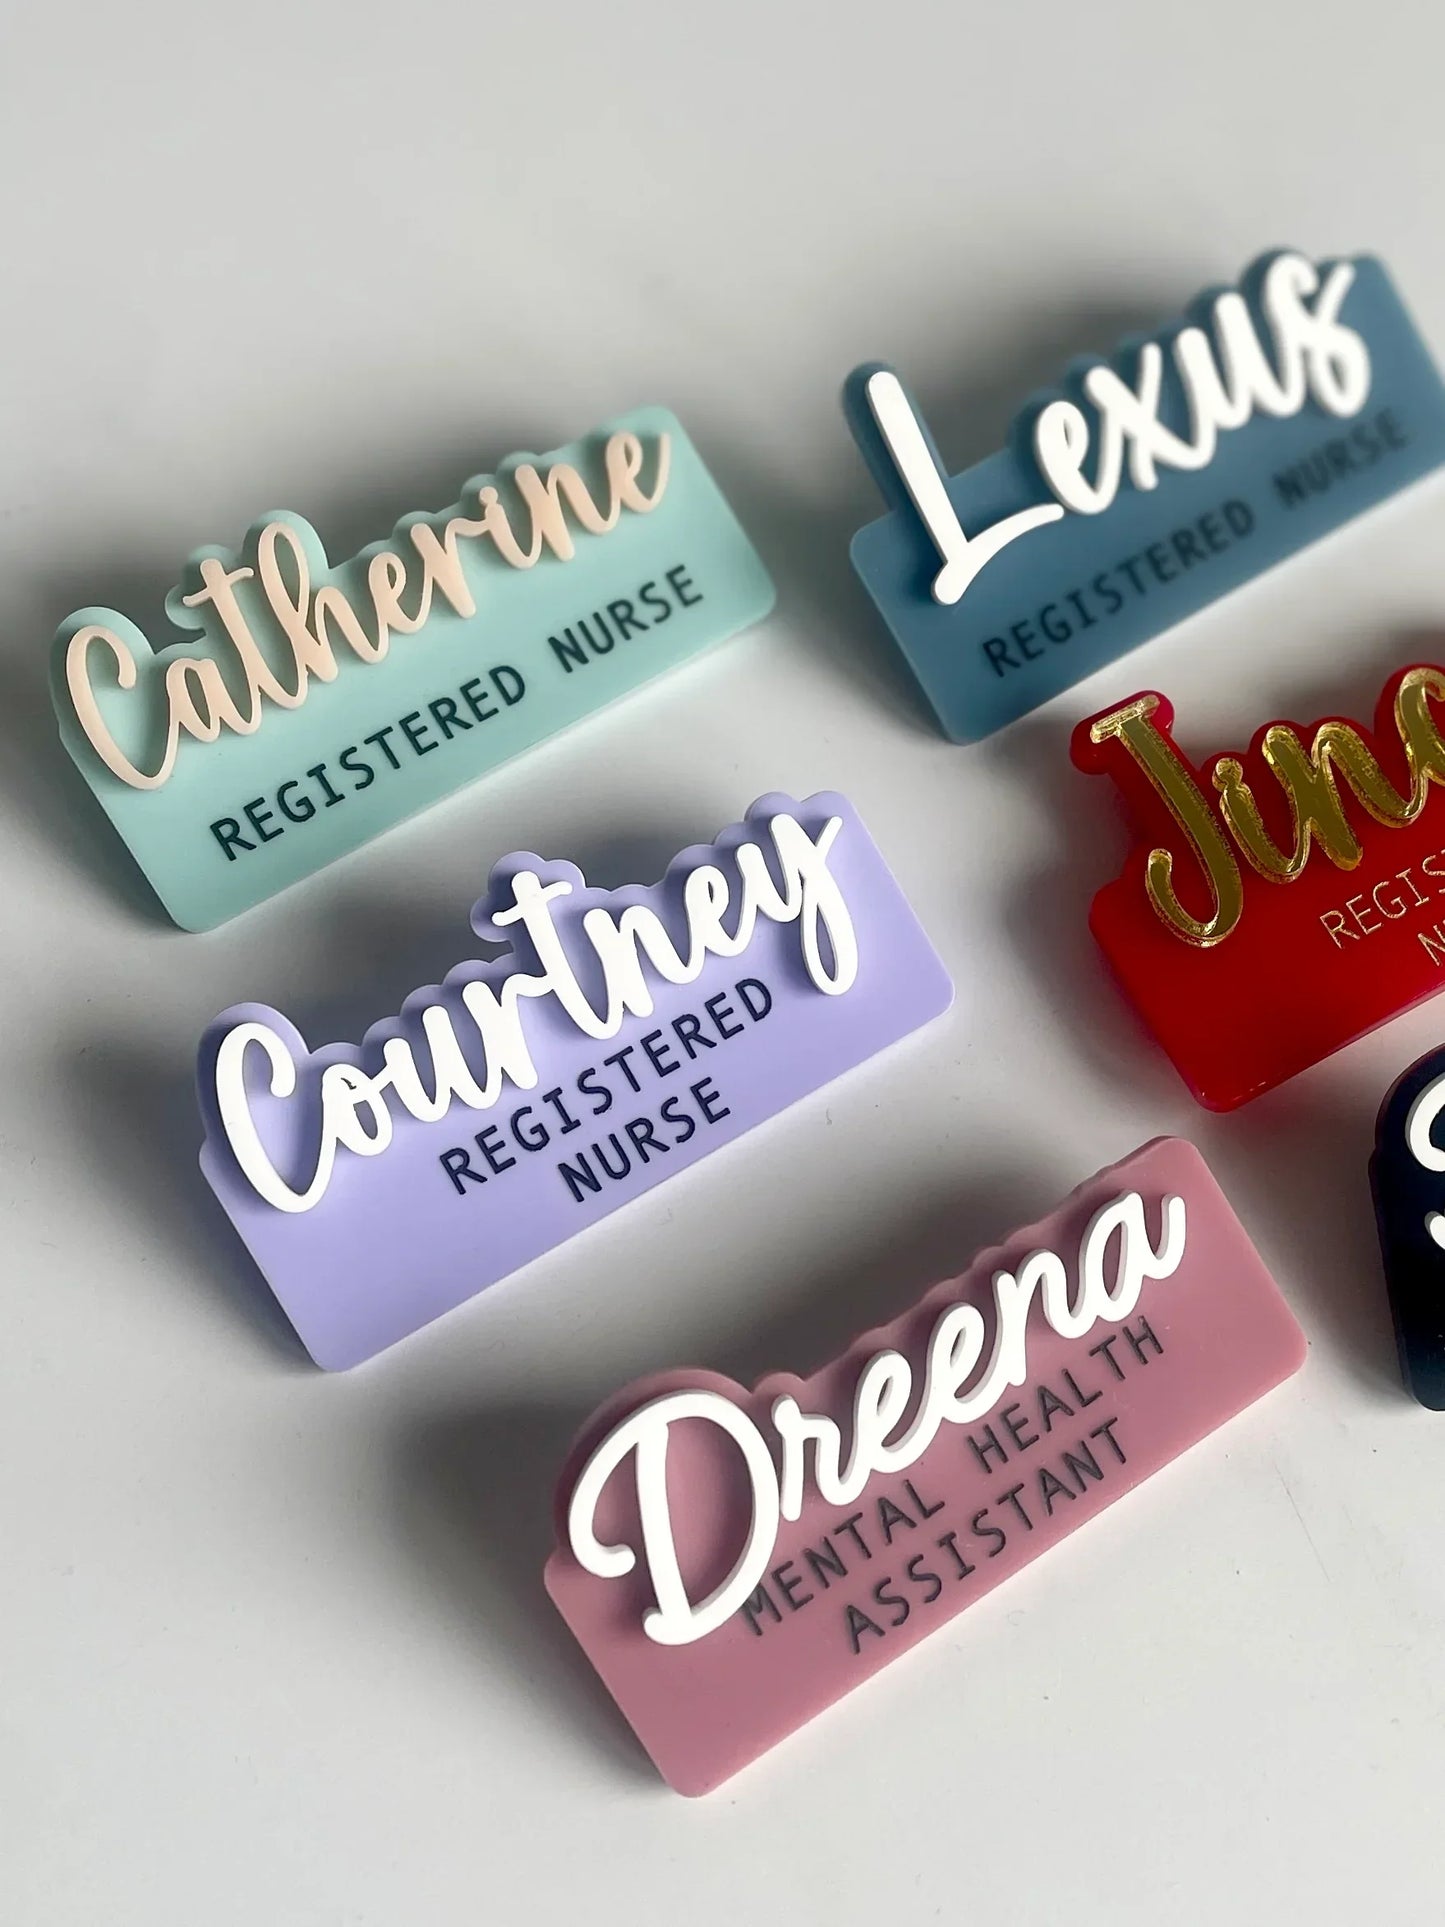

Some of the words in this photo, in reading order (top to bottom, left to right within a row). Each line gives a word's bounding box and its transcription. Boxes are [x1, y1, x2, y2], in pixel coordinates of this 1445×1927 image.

[866, 254, 1370, 606] Lexus
[982, 500, 1256, 678] REGISTERED
[1272, 407, 1410, 508] NURSE
[65, 431, 671, 790] Catherine
[209, 664, 528, 862] REGISTERED
[548, 564, 704, 672] NURSE
[215, 813, 858, 1213] Courtney
[438, 977, 774, 1195] REGISTERED
[557, 1075, 732, 1203] NURSE
[568, 1190, 1186, 1646] Dreena
[739, 1478, 945, 1638] MENTAL
[966, 1316, 1165, 1474] HEALTH
[842, 1415, 1129, 1655] ASSISTANT
